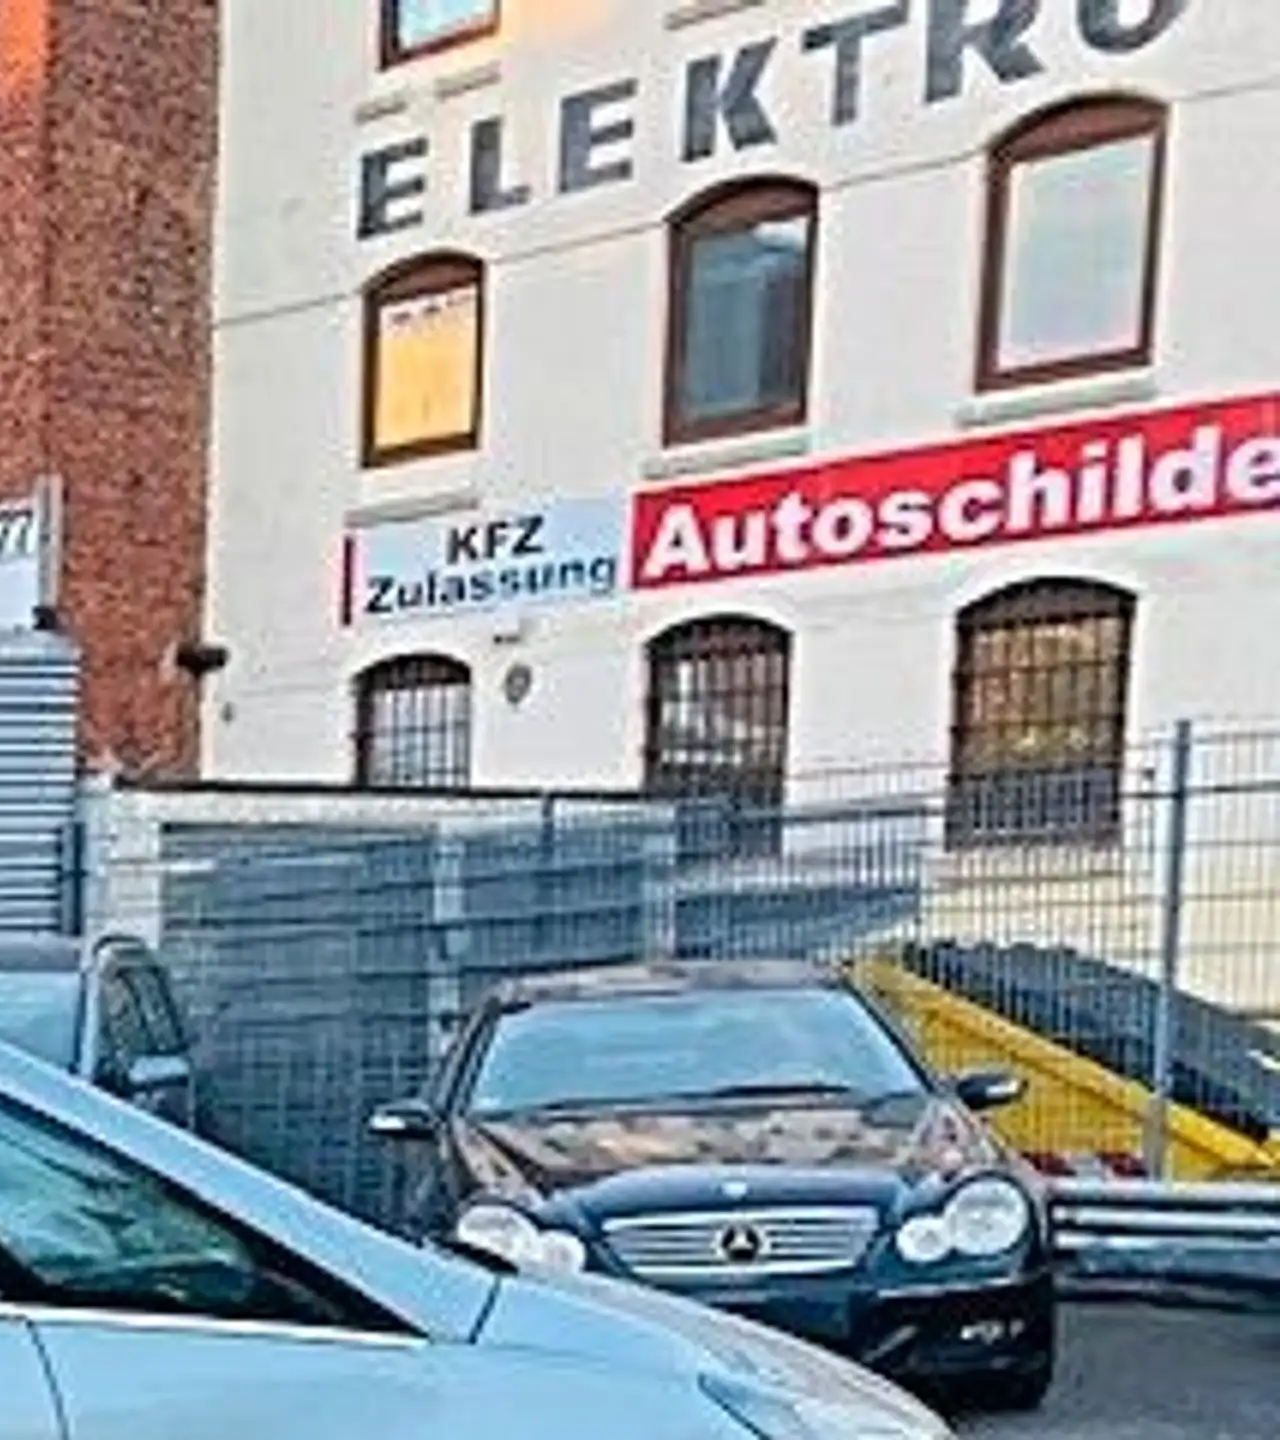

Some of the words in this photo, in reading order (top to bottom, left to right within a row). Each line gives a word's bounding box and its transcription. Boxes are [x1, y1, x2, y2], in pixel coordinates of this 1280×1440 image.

[640, 424, 1280, 580] Autoschilde
[445, 514, 545, 565] KFZ
[365, 555, 616, 613] Zulassung
